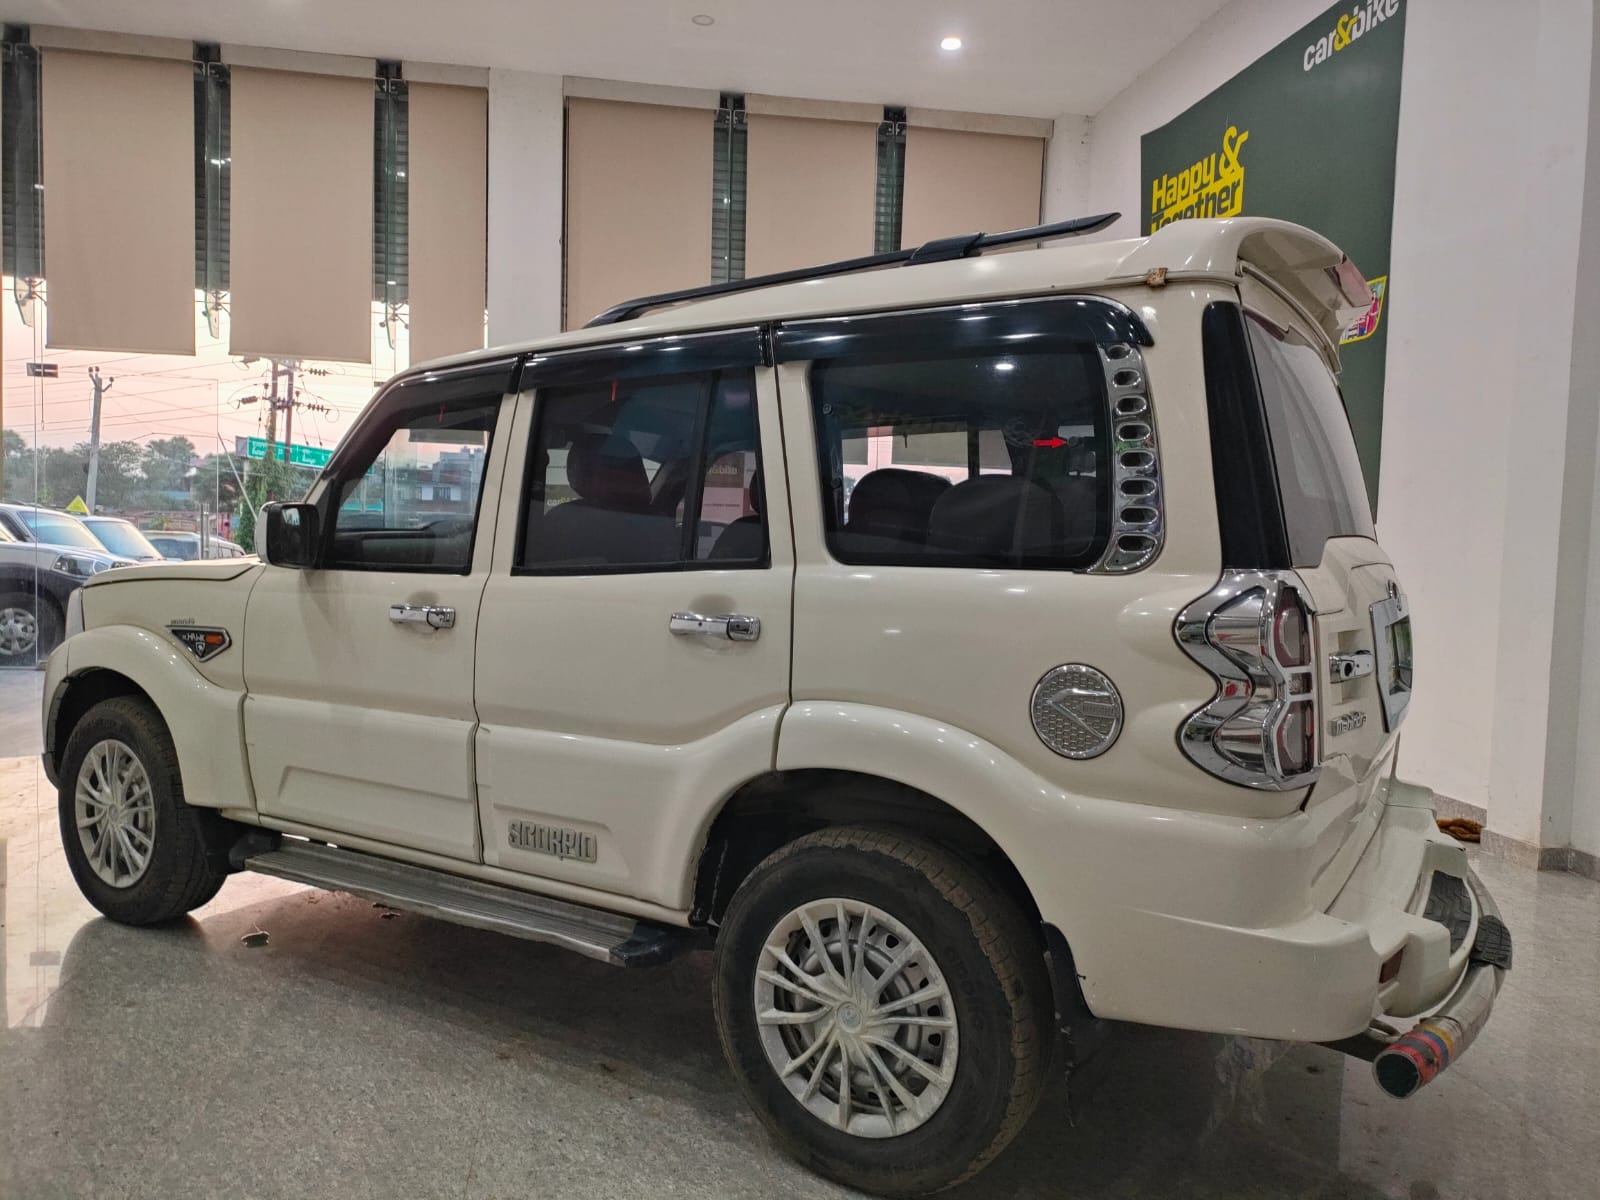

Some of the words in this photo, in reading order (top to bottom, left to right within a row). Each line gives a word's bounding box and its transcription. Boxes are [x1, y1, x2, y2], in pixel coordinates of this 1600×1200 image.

[1303, 0, 1399, 71] car&bike
[1152, 152, 1216, 214] Happy
[1219, 125, 1249, 178] &
[508, 819, 598, 864] SCORPIO
